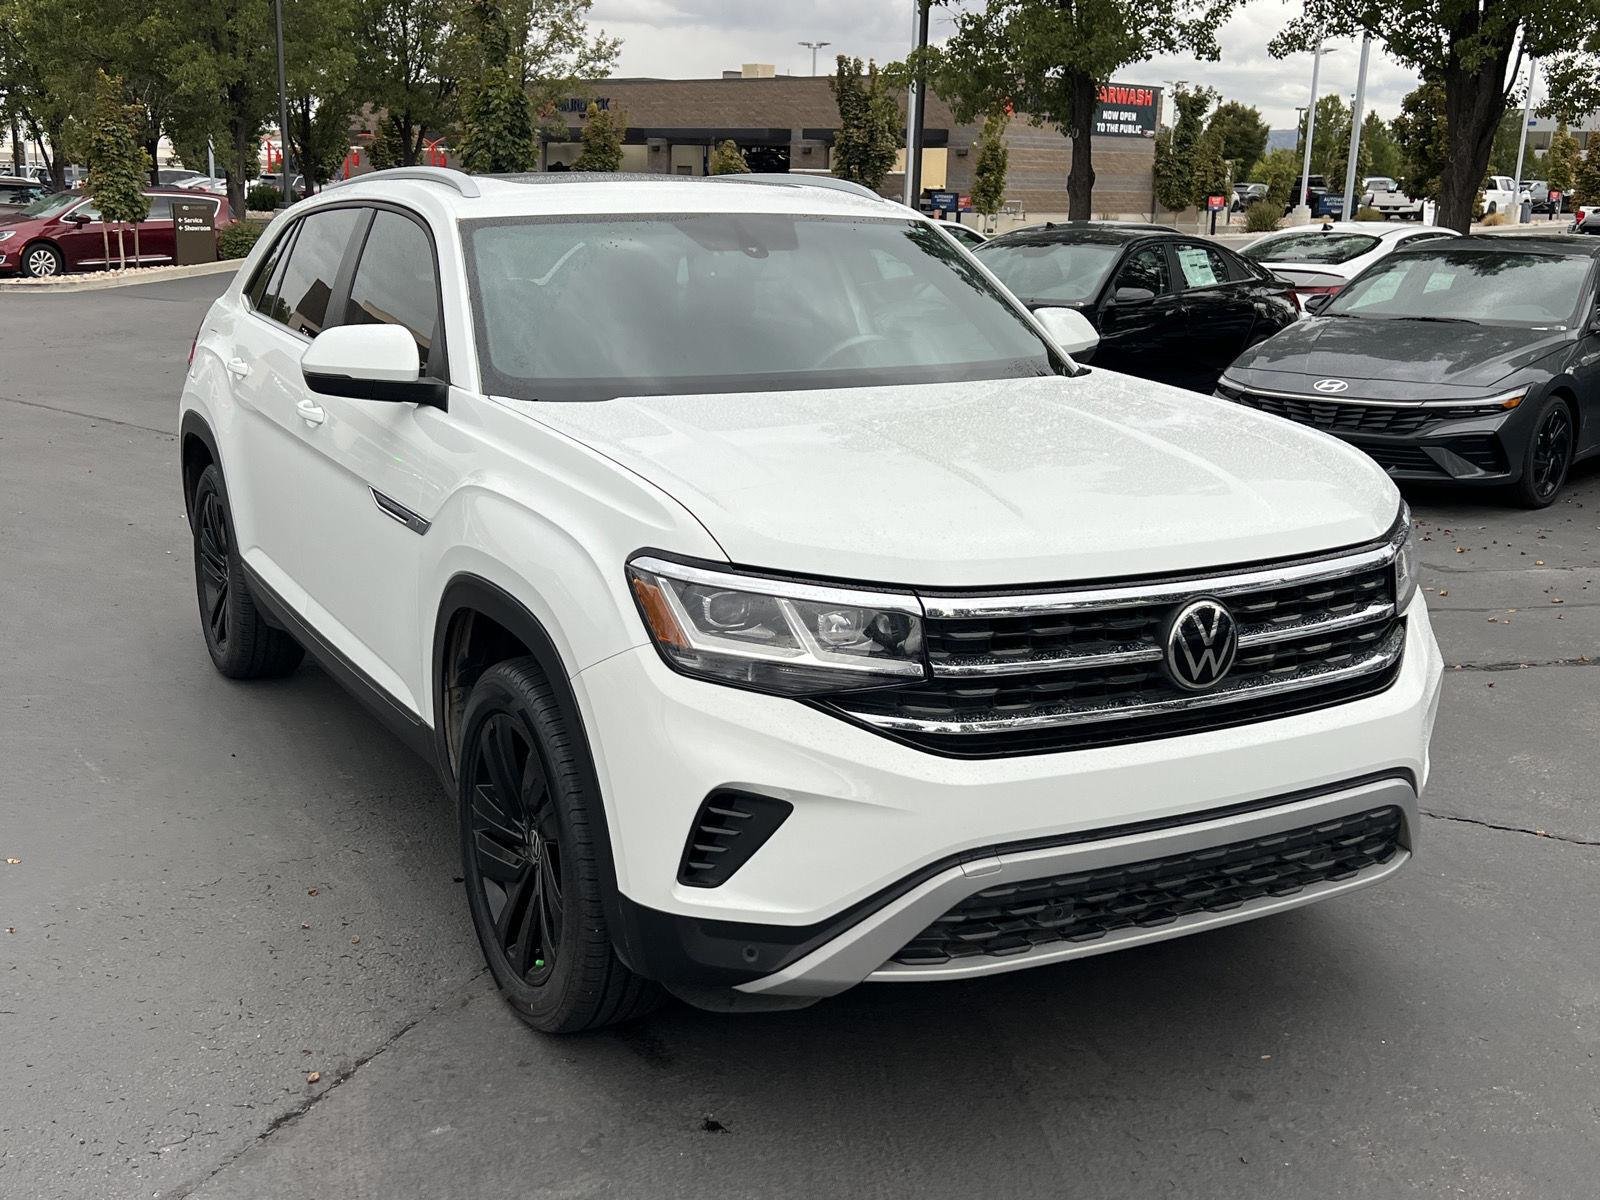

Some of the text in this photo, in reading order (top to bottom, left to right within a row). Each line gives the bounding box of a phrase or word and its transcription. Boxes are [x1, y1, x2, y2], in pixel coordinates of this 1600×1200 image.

[1099, 86, 1153, 106] ARWASH
[1102, 110, 1137, 121] NOW OPEN
[1096, 122, 1106, 132] TO
[1106, 123, 1119, 133] THE
[1120, 124, 1142, 134] PUBLIC
